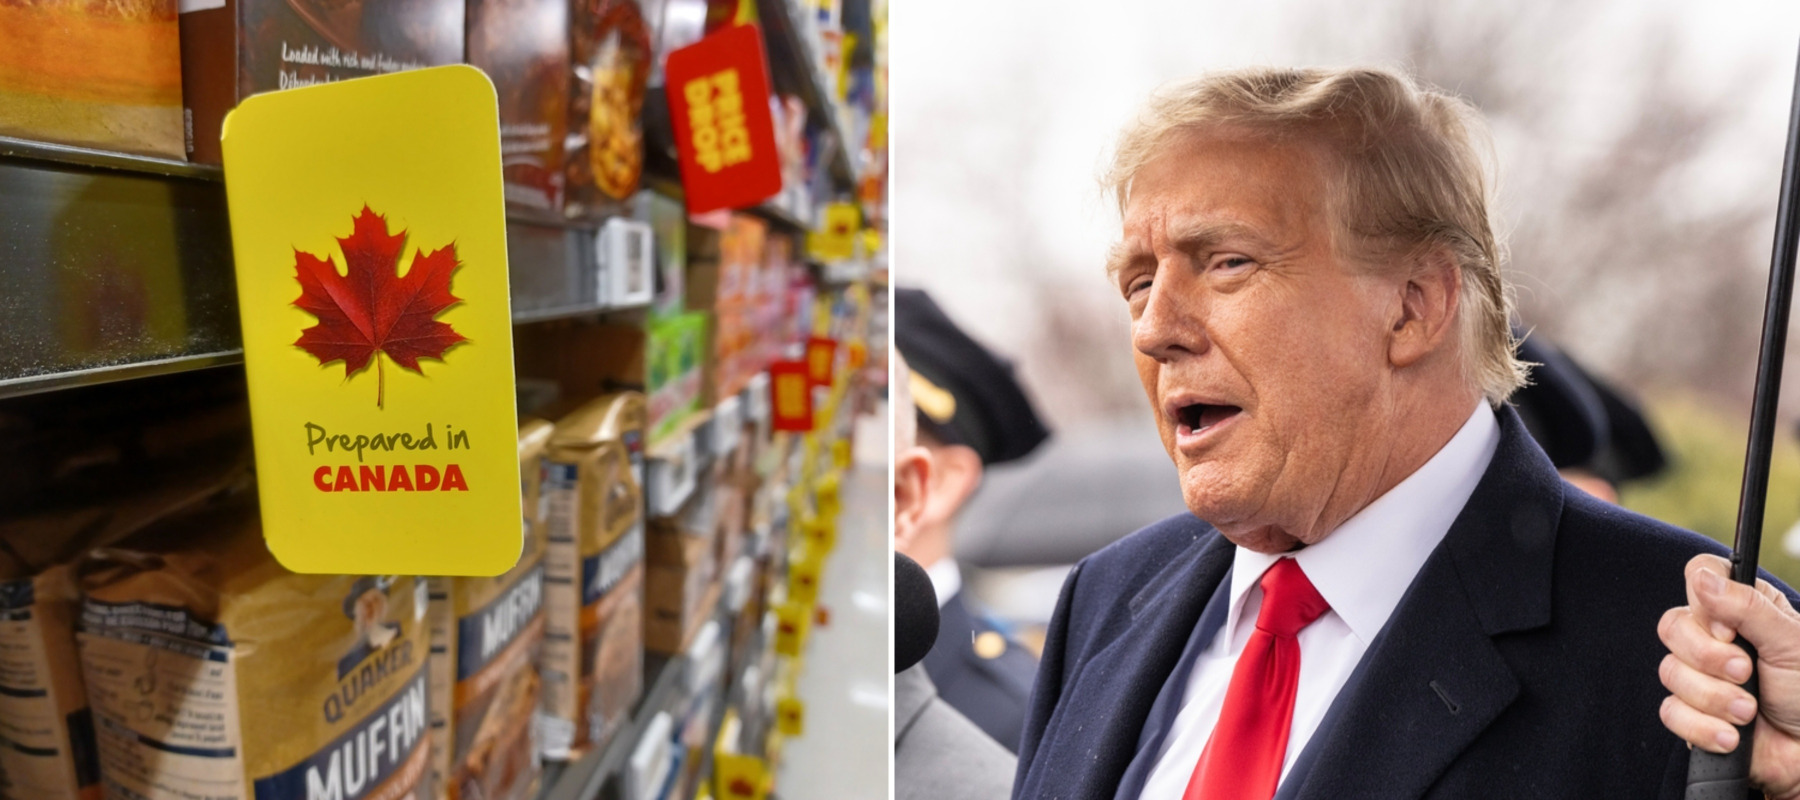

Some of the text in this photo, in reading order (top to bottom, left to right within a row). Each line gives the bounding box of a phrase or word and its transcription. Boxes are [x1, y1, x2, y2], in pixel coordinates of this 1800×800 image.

[282, 40, 319, 65] Loaded
[320, 46, 341, 67] with
[683, 75, 722, 174] DROP
[714, 66, 753, 168] PRICE
[304, 421, 471, 463] Prepared in
[313, 464, 469, 492] CANADA
[323, 640, 413, 724] QUAKER
[305, 676, 425, 800] MUFFIN
